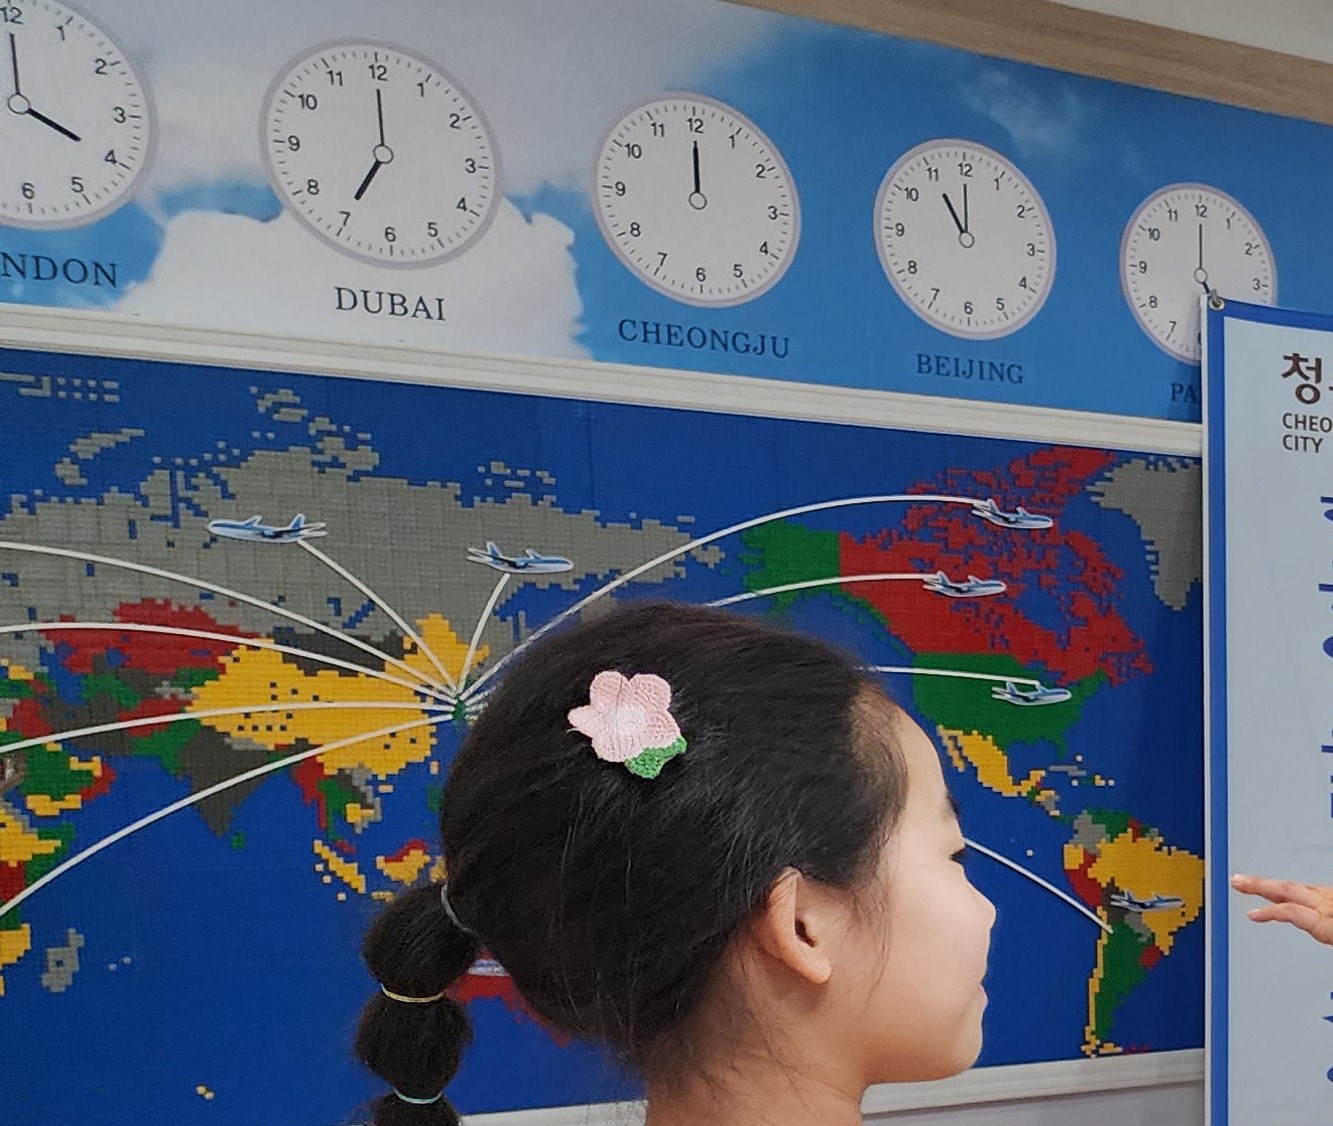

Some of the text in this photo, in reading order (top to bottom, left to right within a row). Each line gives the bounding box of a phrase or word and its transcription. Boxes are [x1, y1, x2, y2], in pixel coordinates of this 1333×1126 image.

[0, 7, 22, 24] 12
[56, 25, 66, 41] 1
[95, 58, 107, 74] 2
[369, 64, 387, 81] 12
[327, 70, 343, 86] 11
[417, 82, 425, 98] 1
[298, 94, 317, 110] 10
[114, 107, 126, 123] 3
[450, 113, 460, 129] 2
[651, 122, 664, 137] 11
[687, 118, 703, 134] 12
[288, 135, 300, 151] 9
[728, 134, 736, 149] 1
[105, 150, 117, 164] 4
[625, 143, 642, 159] 10
[466, 158, 476, 173] 3
[756, 164, 765, 178] 2
[958, 163, 972, 177] 12
[927, 167, 938, 181] 11
[22, 183, 34, 199] 6
[72, 177, 83, 193] 5
[307, 179, 319, 195] 8
[615, 181, 625, 196] 9
[993, 177, 1000, 191] 1
[904, 187, 918, 201] 10
[457, 197, 467, 211] 4
[1195, 205, 1207, 217] 12
[340, 211, 351, 226] 7
[768, 206, 777, 220] 3
[1017, 205, 1025, 218] 2
[1167, 209, 1177, 221] 11
[428, 222, 438, 237] 5
[630, 222, 641, 237] 8
[895, 223, 904, 236] 9
[1225, 217, 1231, 230] 1
[385, 227, 396, 242] 6
[1148, 228, 1160, 241] 10
[759, 242, 768, 255] 4
[1027, 243, 1035, 256] 3
[1245, 243, 1252, 255] 2
[658, 252, 667, 266] 7
[0, 252, 117, 288] NDON
[734, 264, 743, 278] 5
[908, 261, 917, 274] 8
[1139, 261, 1147, 274] 9
[696, 268, 706, 282] 6
[1019, 276, 1027, 288] 4
[1253, 278, 1260, 291] 3
[931, 288, 940, 300] 7
[334, 286, 447, 323] DUBAI
[964, 302, 973, 315] 6
[997, 298, 1004, 311] 5
[1149, 296, 1157, 308] 8
[1169, 321, 1176, 332] 7
[617, 317, 790, 360] CHEONGJU
[915, 353, 1025, 386] BEIJING
[1171, 383, 1198, 403] PA
[1282, 434, 1324, 454] CITY
